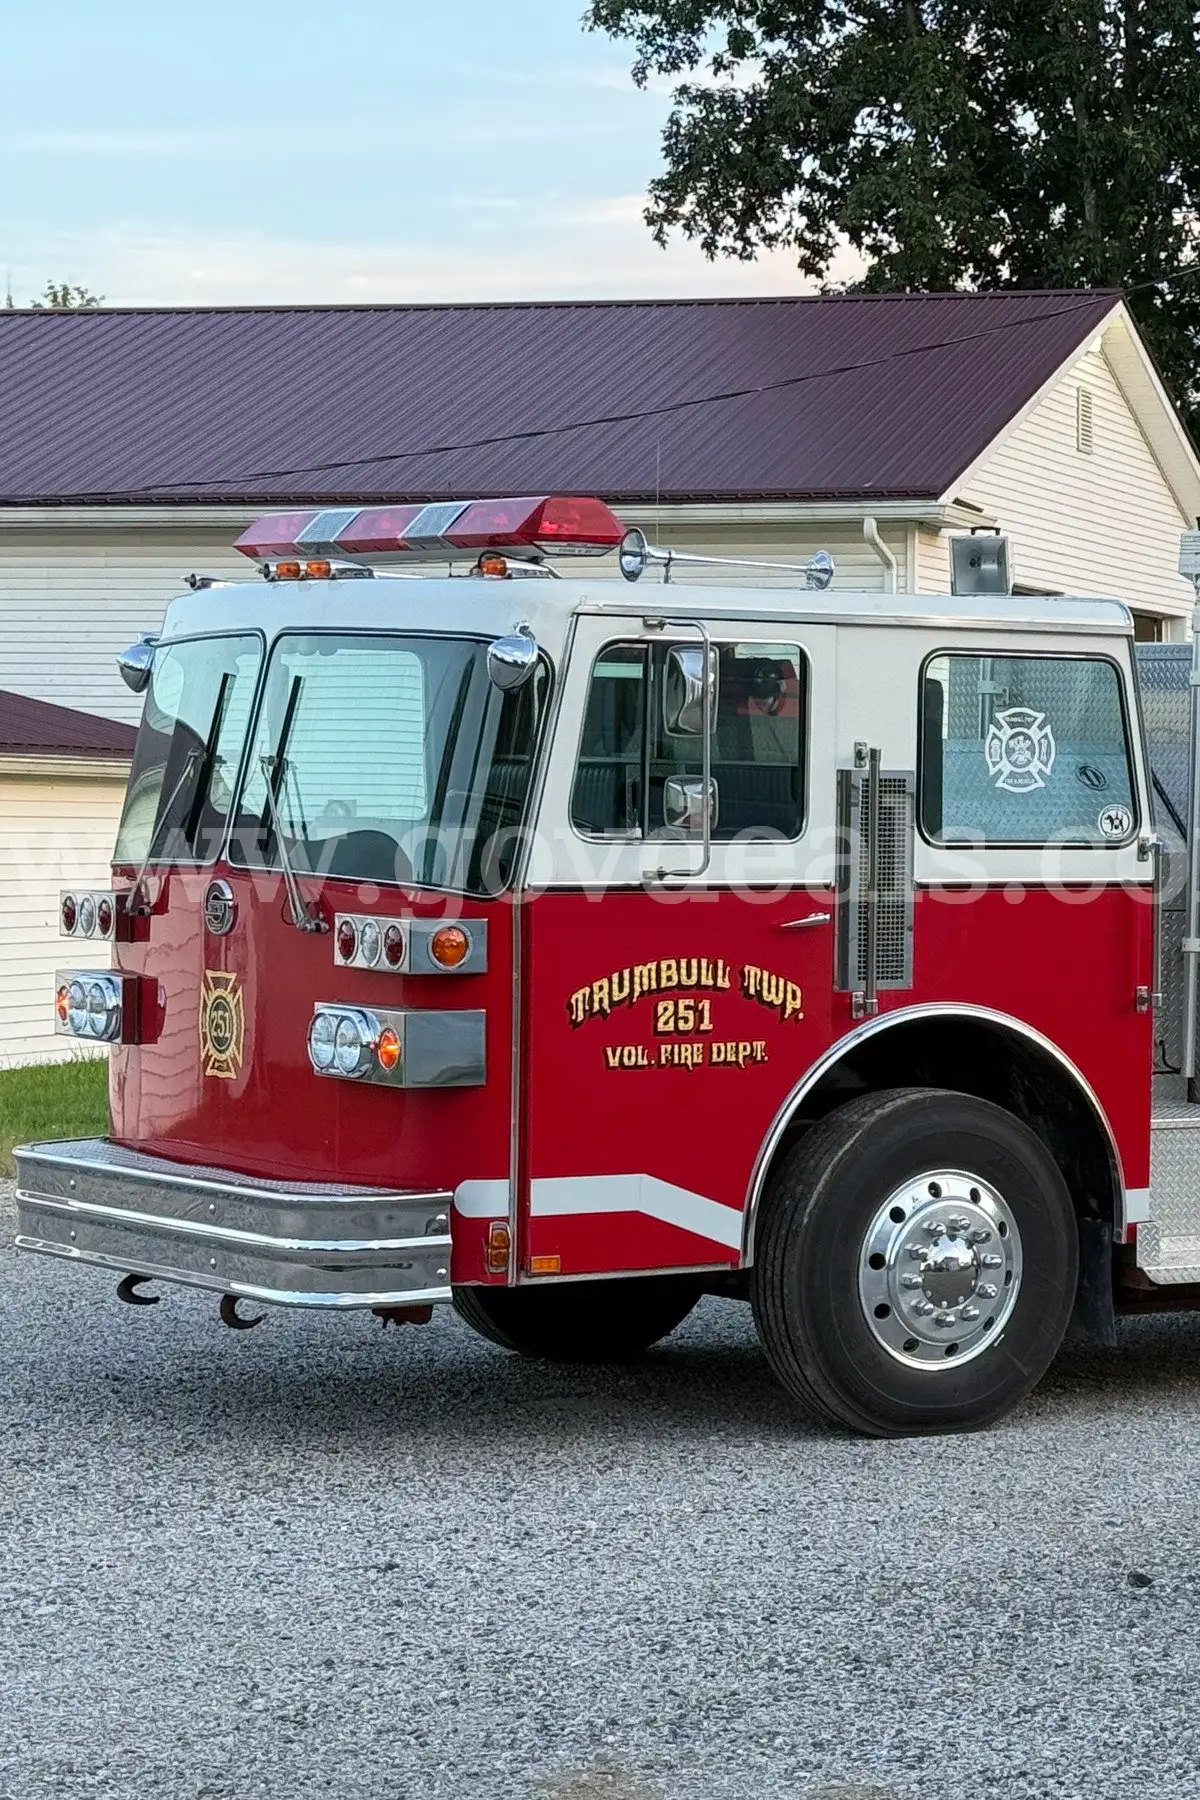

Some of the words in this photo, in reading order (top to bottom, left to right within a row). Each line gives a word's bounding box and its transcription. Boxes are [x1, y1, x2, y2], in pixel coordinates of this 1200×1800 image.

[568, 957, 732, 1026] TRUMBULL
[742, 963, 805, 1021] TWP.
[210, 1010, 232, 1039] 251
[656, 998, 714, 1033] 251
[604, 1044, 656, 1068] VOL.
[659, 1042, 704, 1071] FIRE
[711, 1040, 769, 1069] DEPT.
